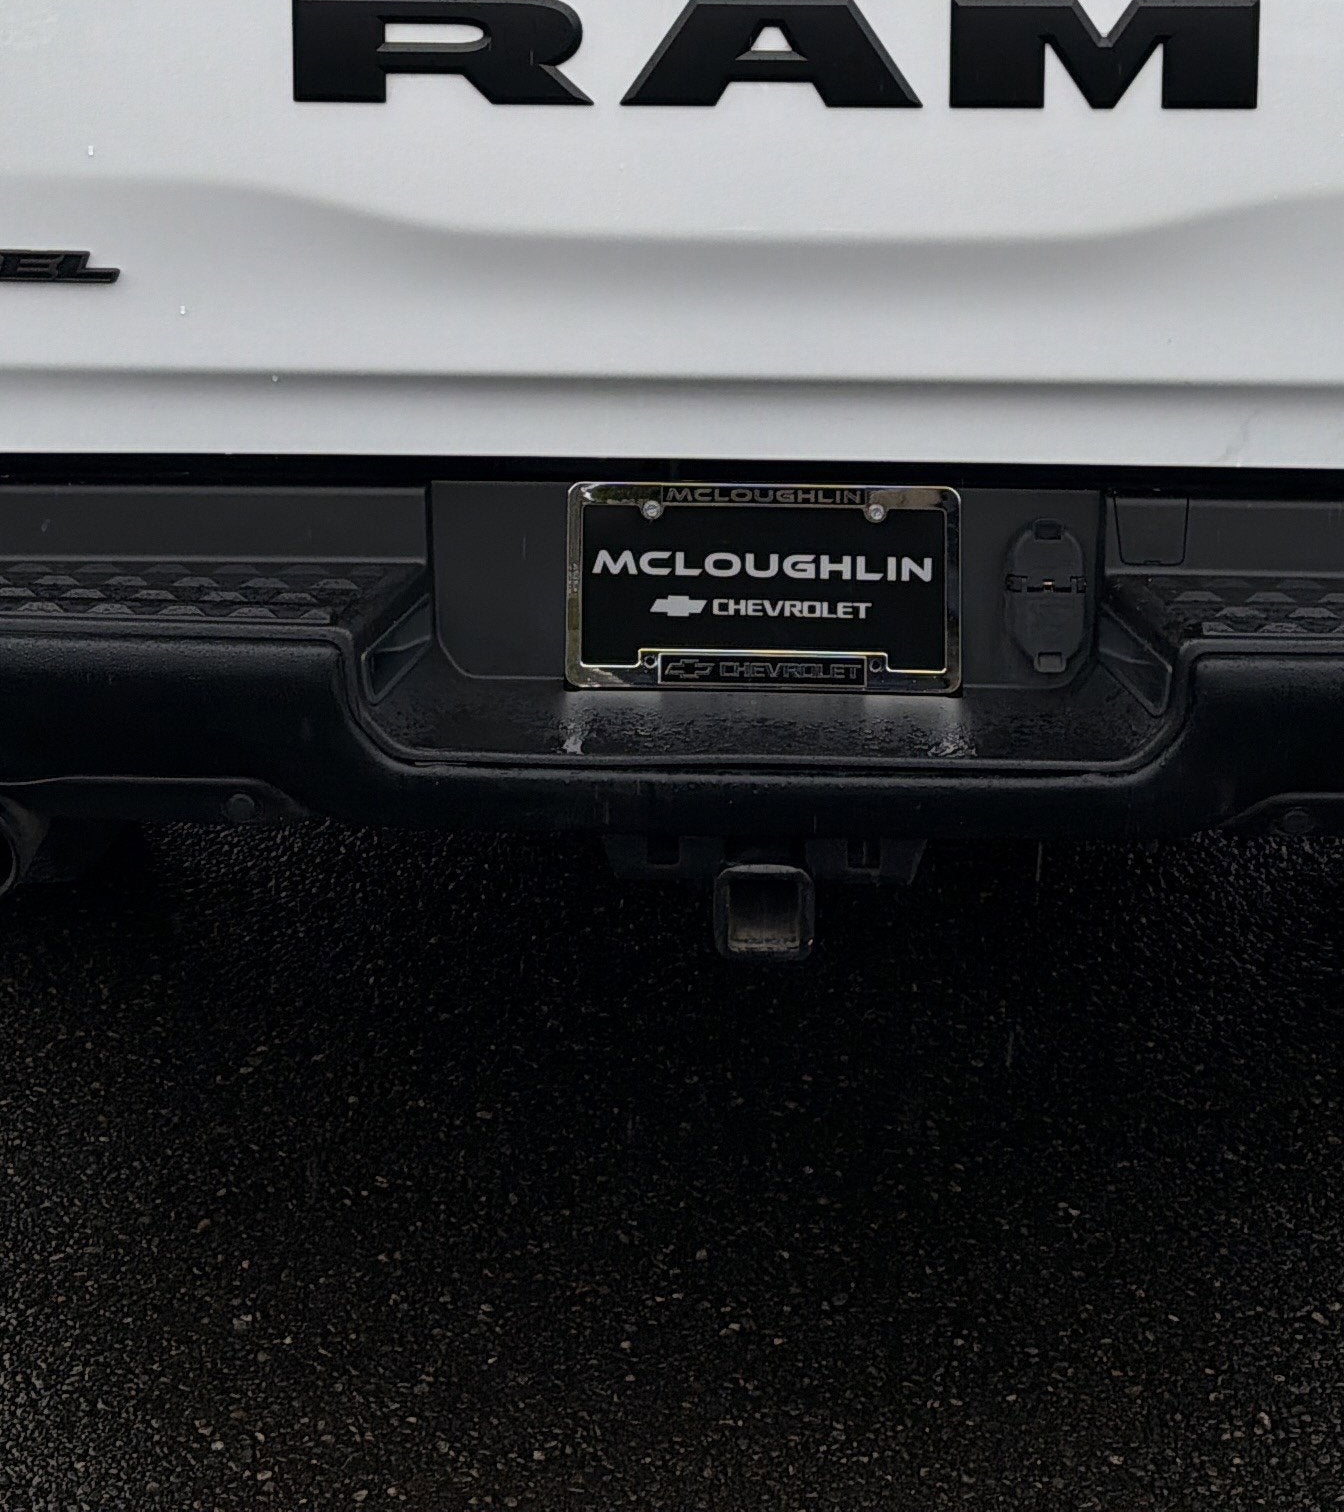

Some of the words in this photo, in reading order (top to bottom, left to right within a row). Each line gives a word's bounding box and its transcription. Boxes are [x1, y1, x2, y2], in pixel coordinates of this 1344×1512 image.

[665, 487, 862, 504] MCLOUGHLIN
[591, 549, 933, 583] MCLOUGHLIN
[712, 597, 873, 620] CHEVROLET
[719, 661, 862, 679] CHEVROLET
